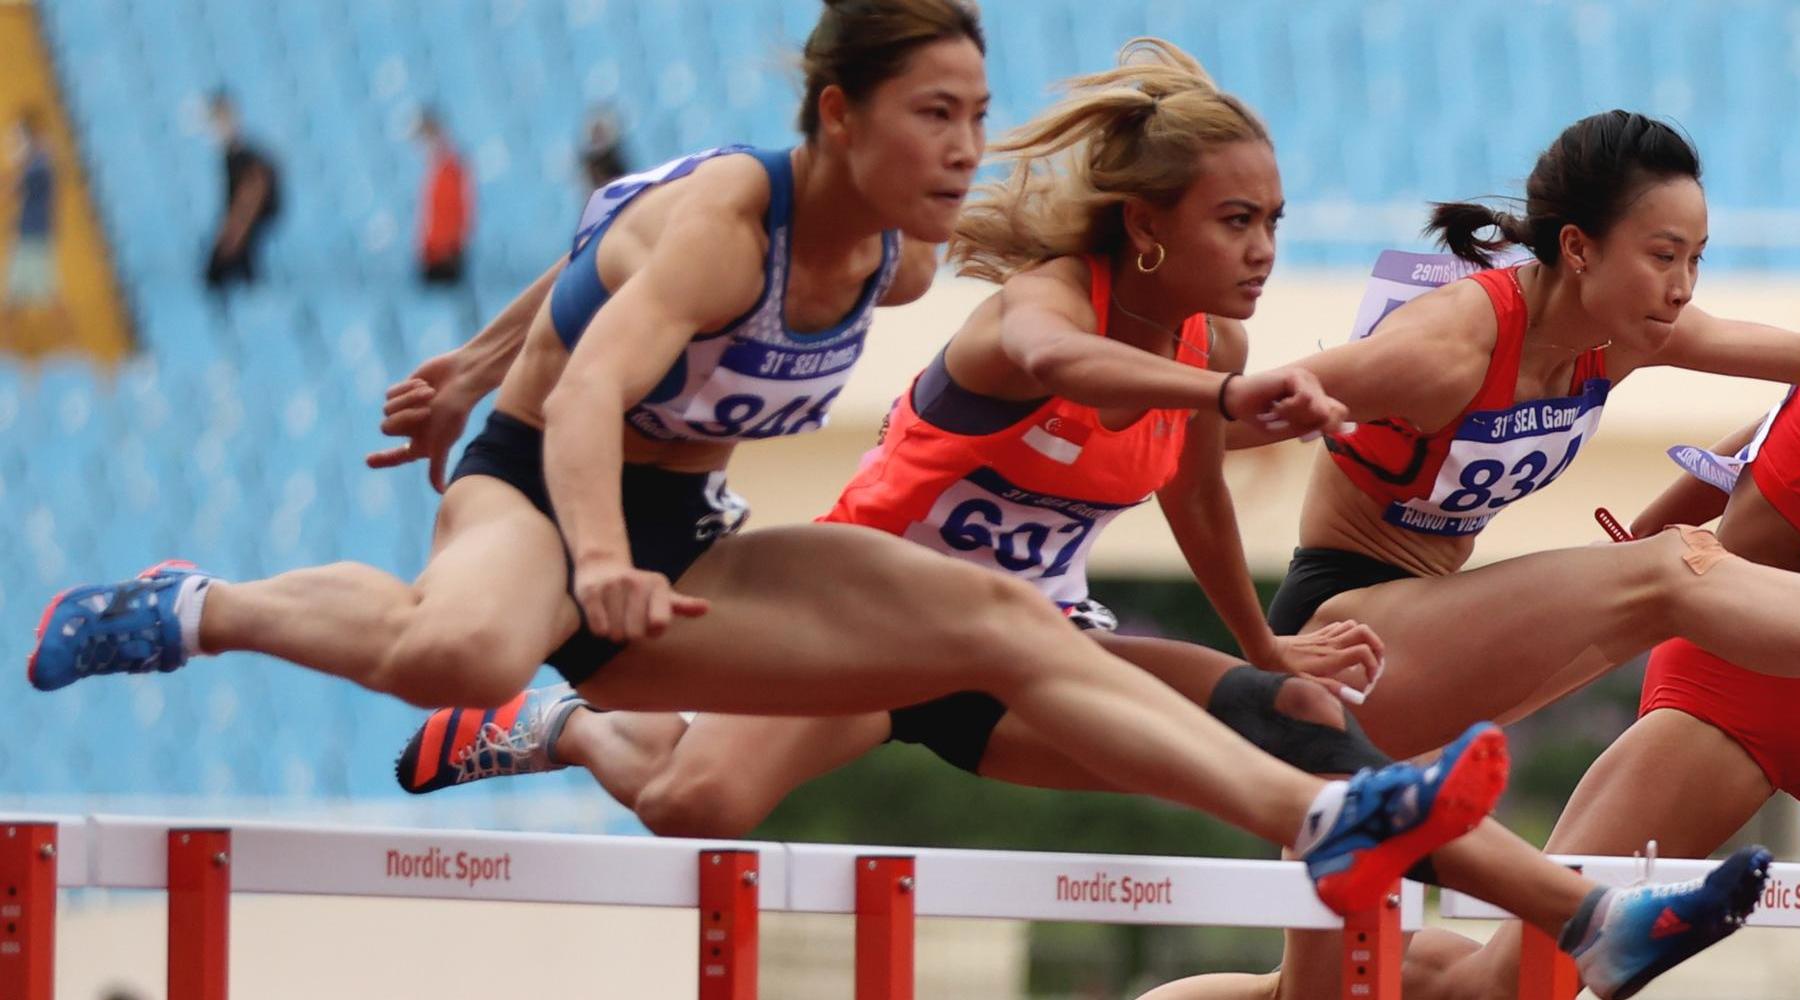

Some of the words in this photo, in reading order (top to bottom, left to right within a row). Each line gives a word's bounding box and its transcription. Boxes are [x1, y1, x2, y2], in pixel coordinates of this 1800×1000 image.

[1514, 407, 1538, 434] SEA
[1542, 405, 1581, 430] Gam
[455, 851, 511, 887] Sport
[1121, 876, 1172, 910] Sport
